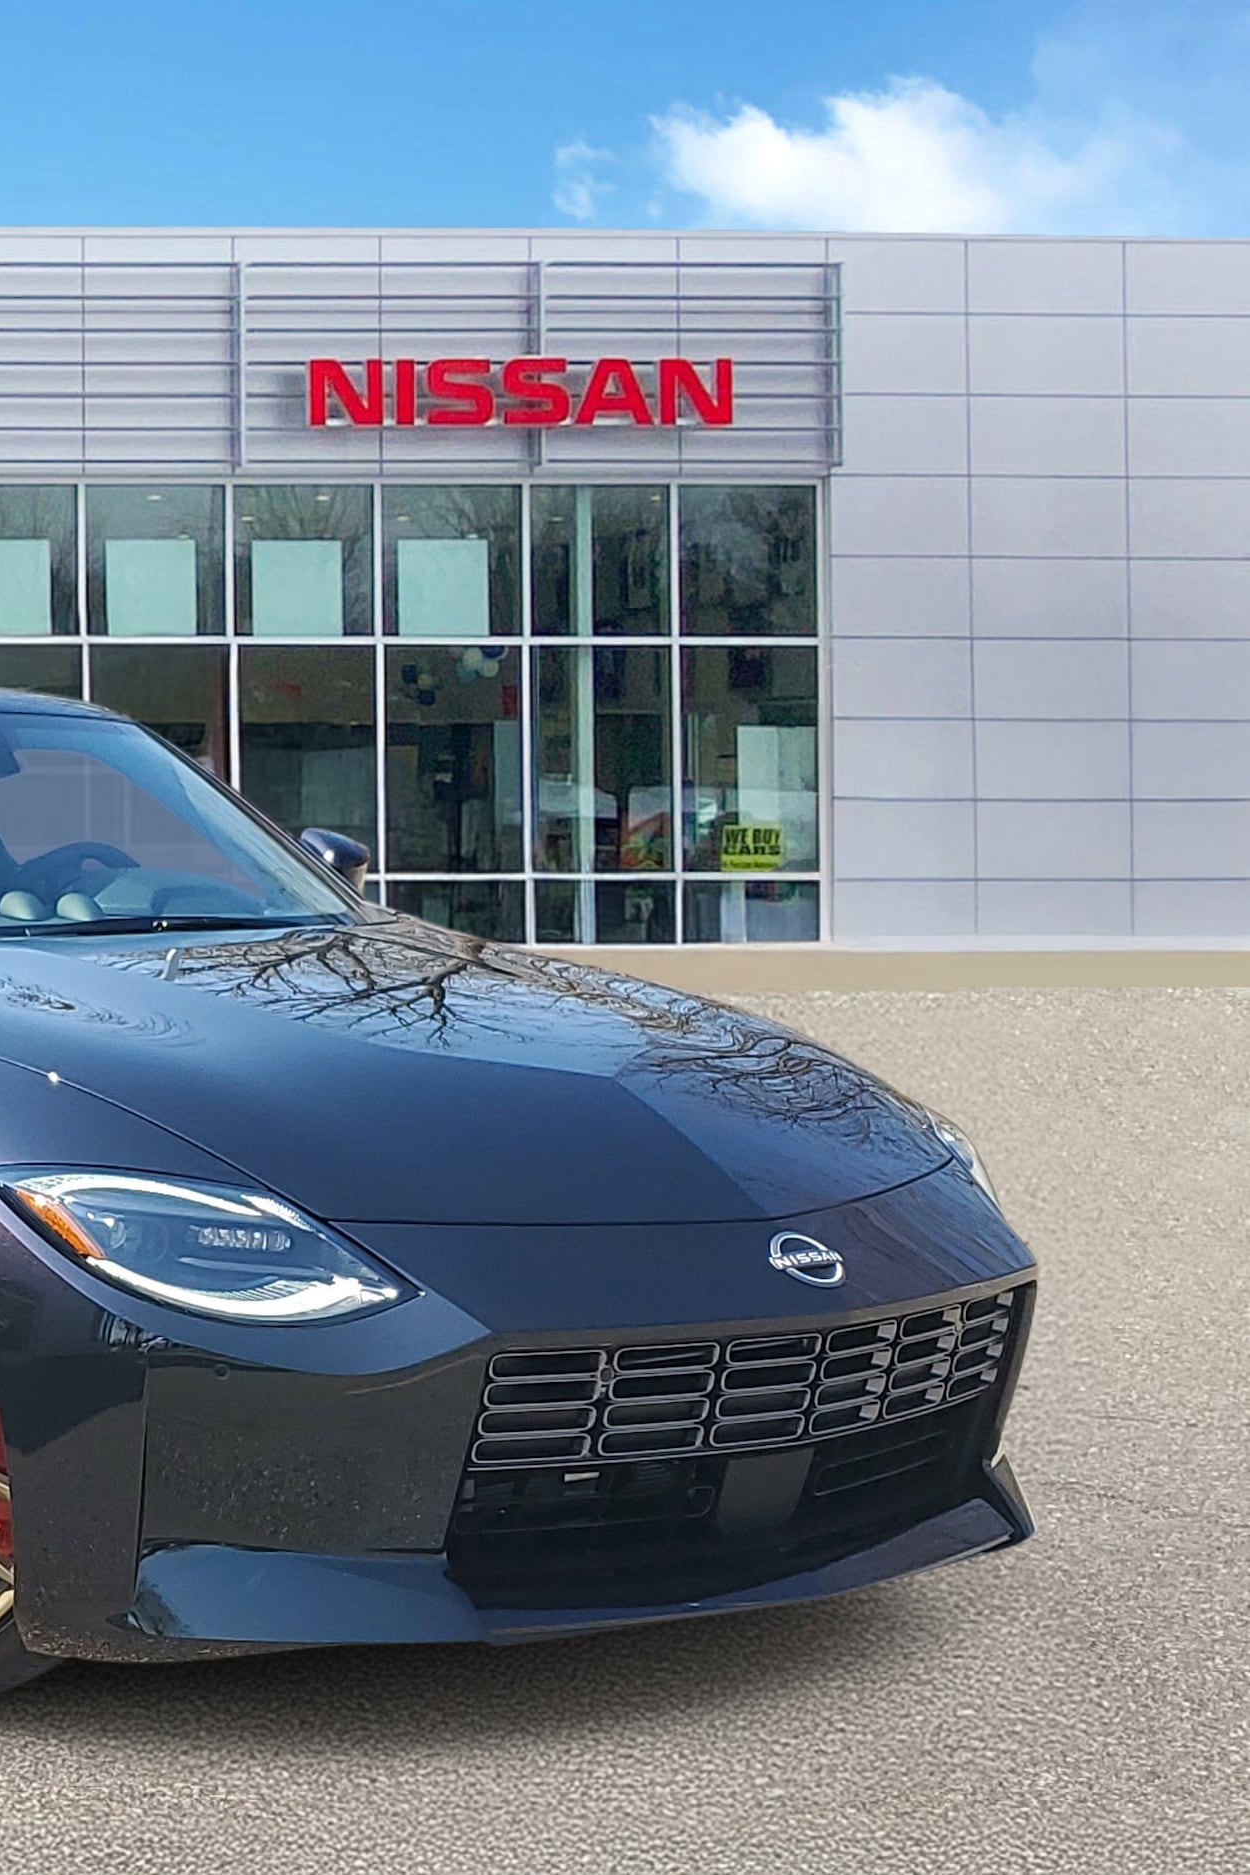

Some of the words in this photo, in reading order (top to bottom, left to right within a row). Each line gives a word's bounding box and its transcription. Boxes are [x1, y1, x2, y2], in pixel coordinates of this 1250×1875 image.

[309, 358, 734, 426] NISSAN
[726, 828, 748, 844] WE
[753, 828, 781, 844] BUY
[724, 844, 781, 855] CARS
[774, 1251, 843, 1269] NISSAN
